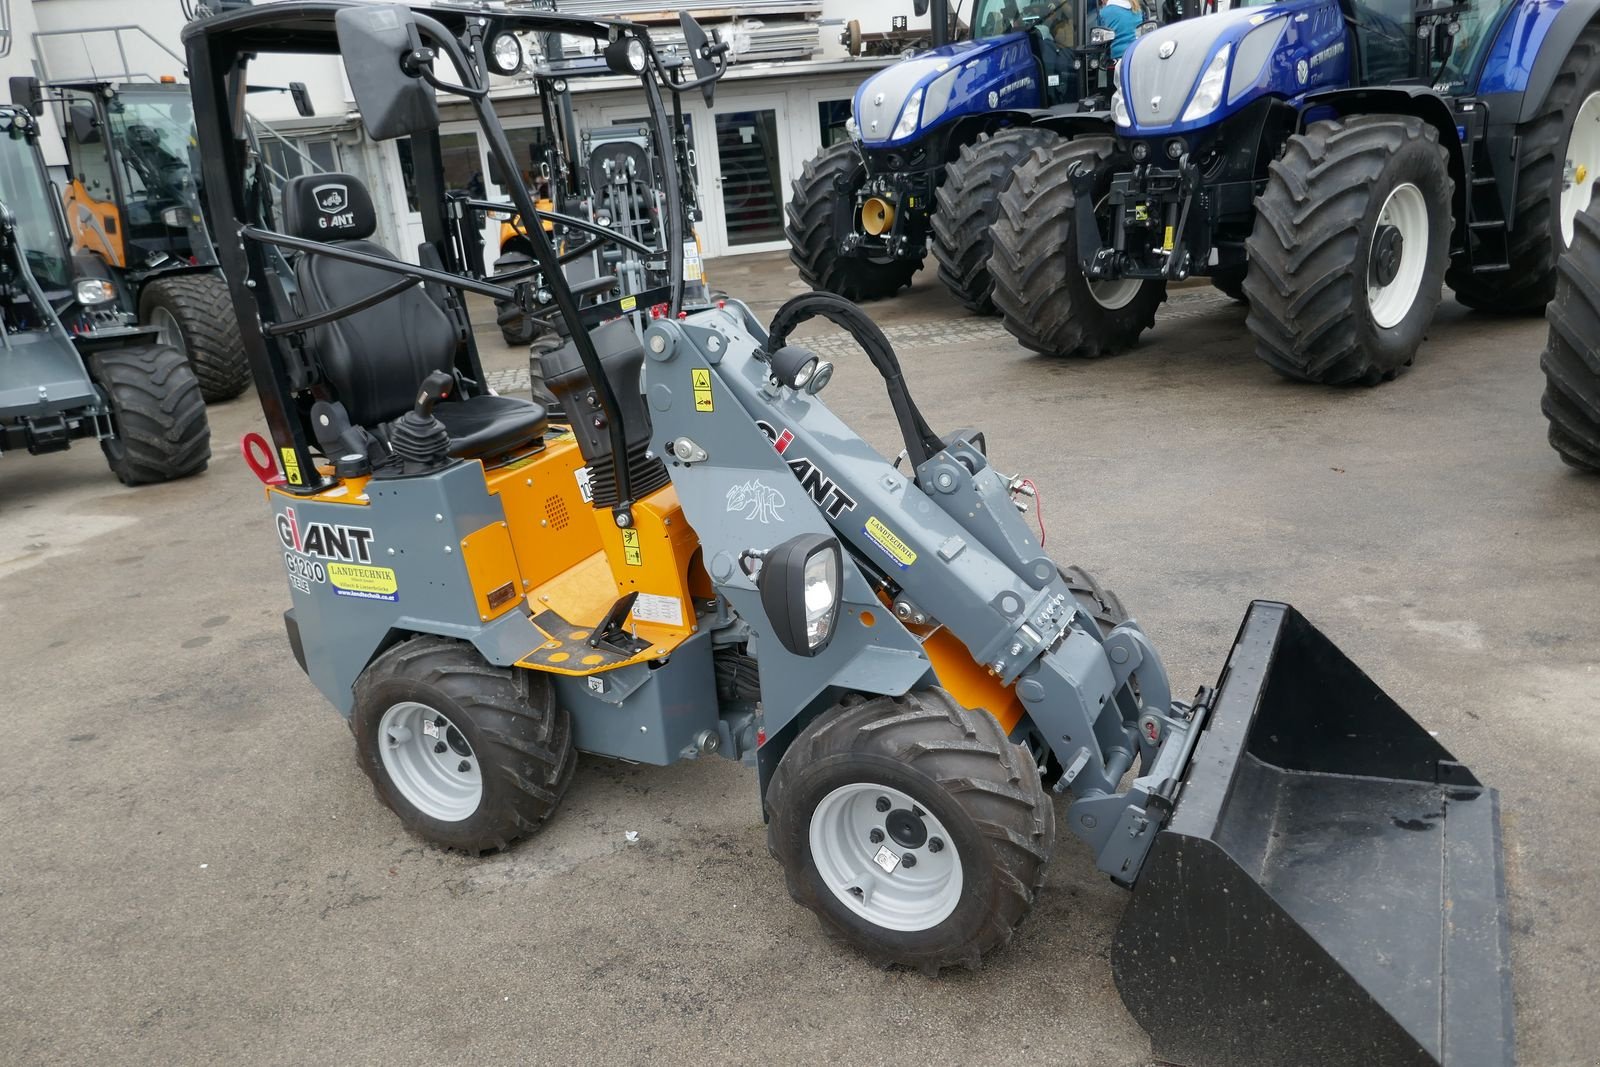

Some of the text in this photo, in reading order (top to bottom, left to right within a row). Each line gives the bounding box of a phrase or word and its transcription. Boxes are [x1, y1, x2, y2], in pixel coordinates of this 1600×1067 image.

[870, 519, 913, 559] LANDTECHNIK
[285, 551, 326, 584] G1200
[330, 565, 393, 581] LANDTECHNIK
[337, 590, 395, 601] www.landtechnik.co.at
